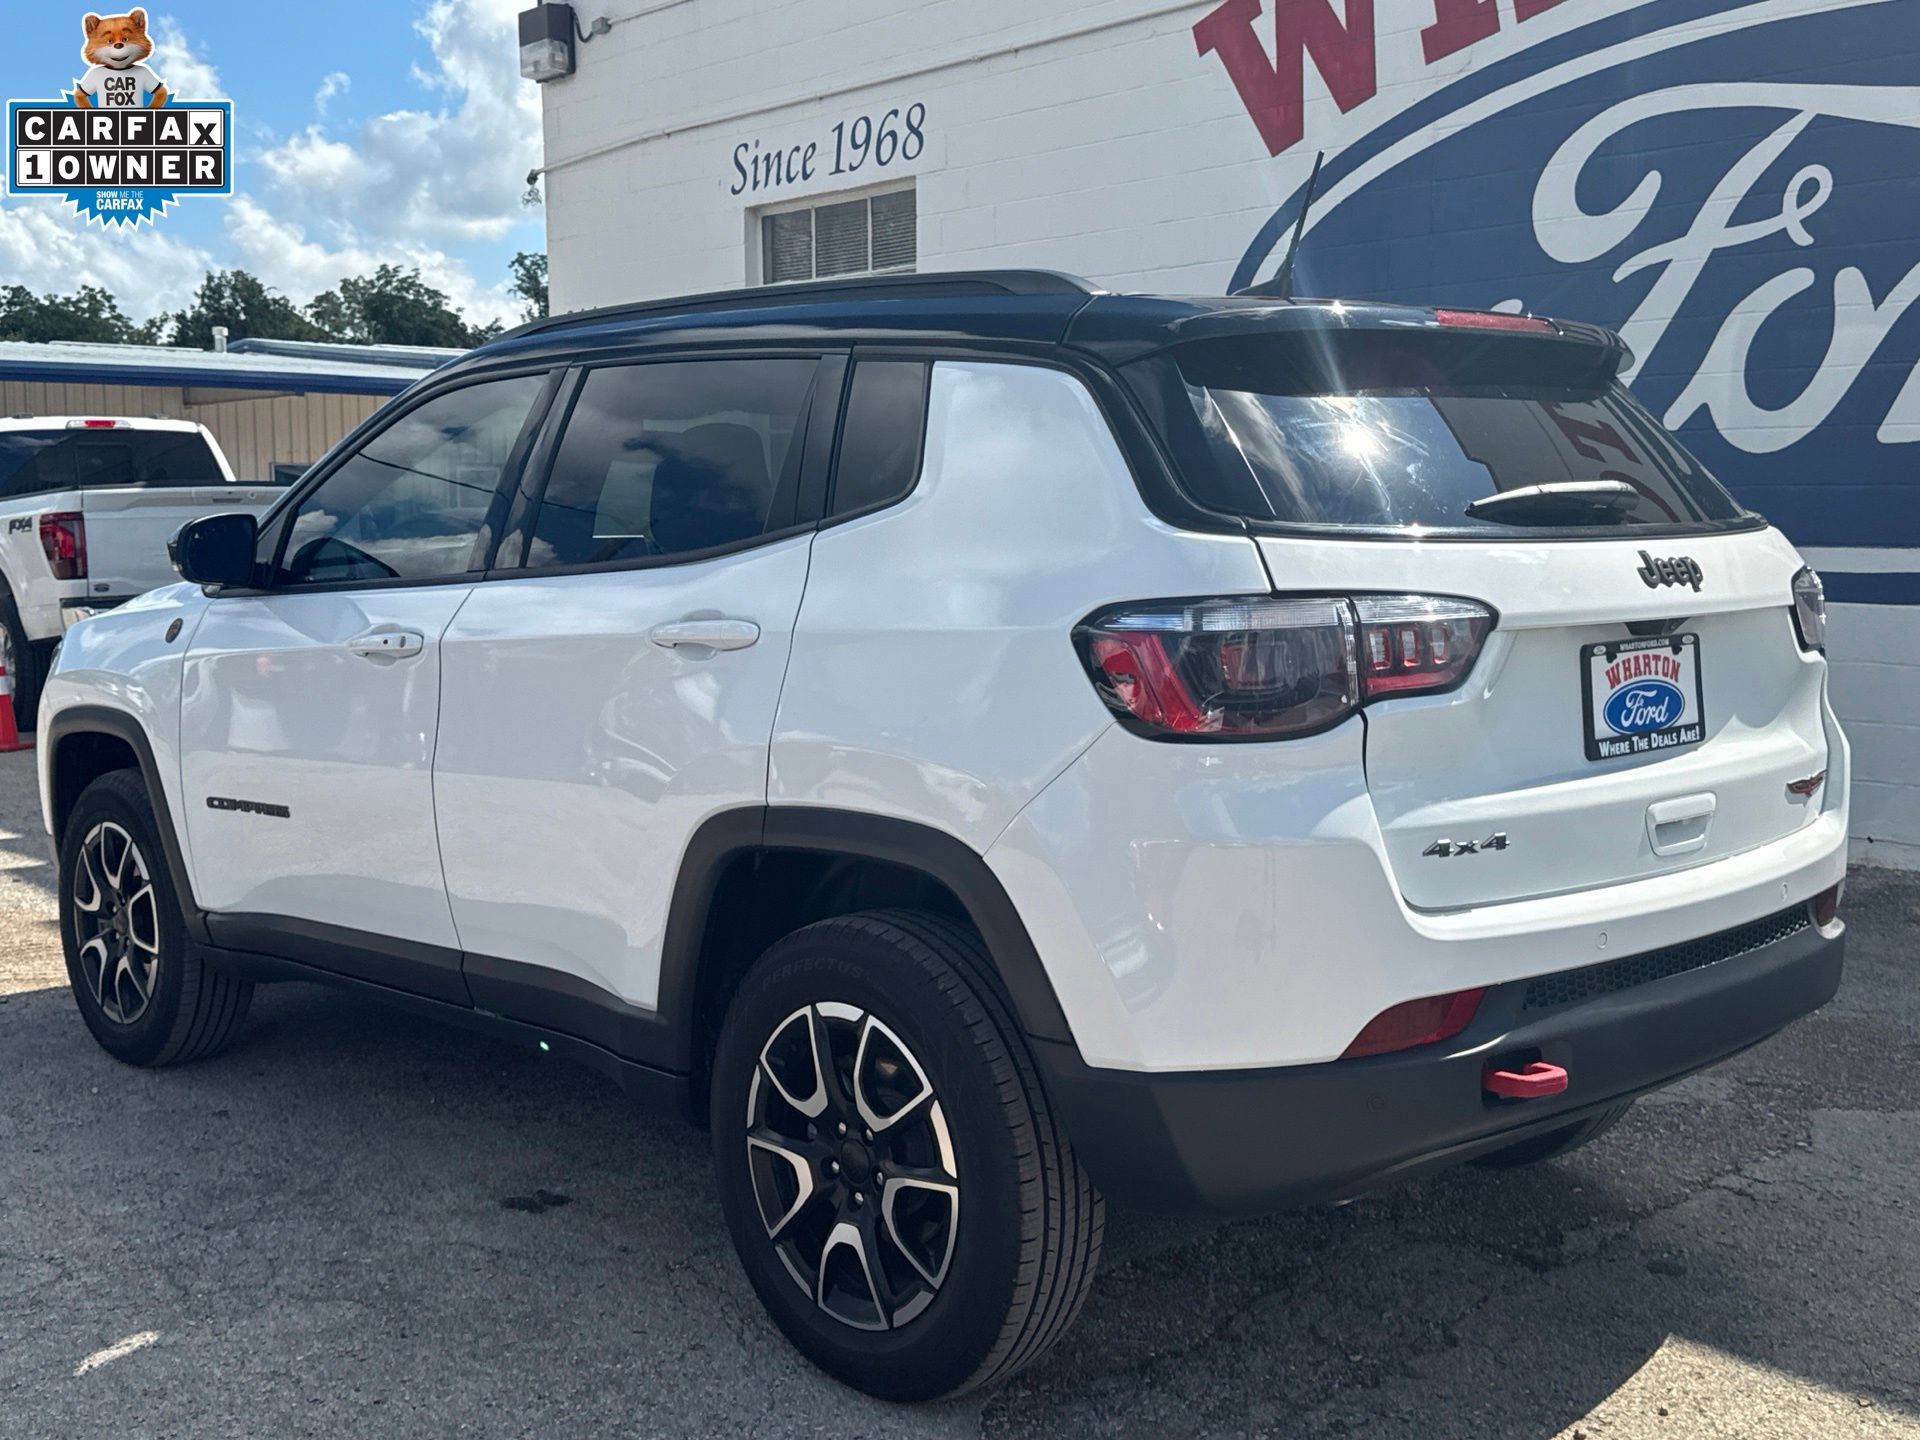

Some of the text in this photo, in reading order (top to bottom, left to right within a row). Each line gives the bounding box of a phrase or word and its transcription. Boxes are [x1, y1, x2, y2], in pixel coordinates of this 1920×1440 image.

[730, 102, 926, 196] Since 1968
[1636, 550, 1704, 593] Jeep
[1605, 654, 1681, 690] WHARTON
[1620, 689, 1669, 728] Ford
[1422, 831, 1511, 858] 4x4
